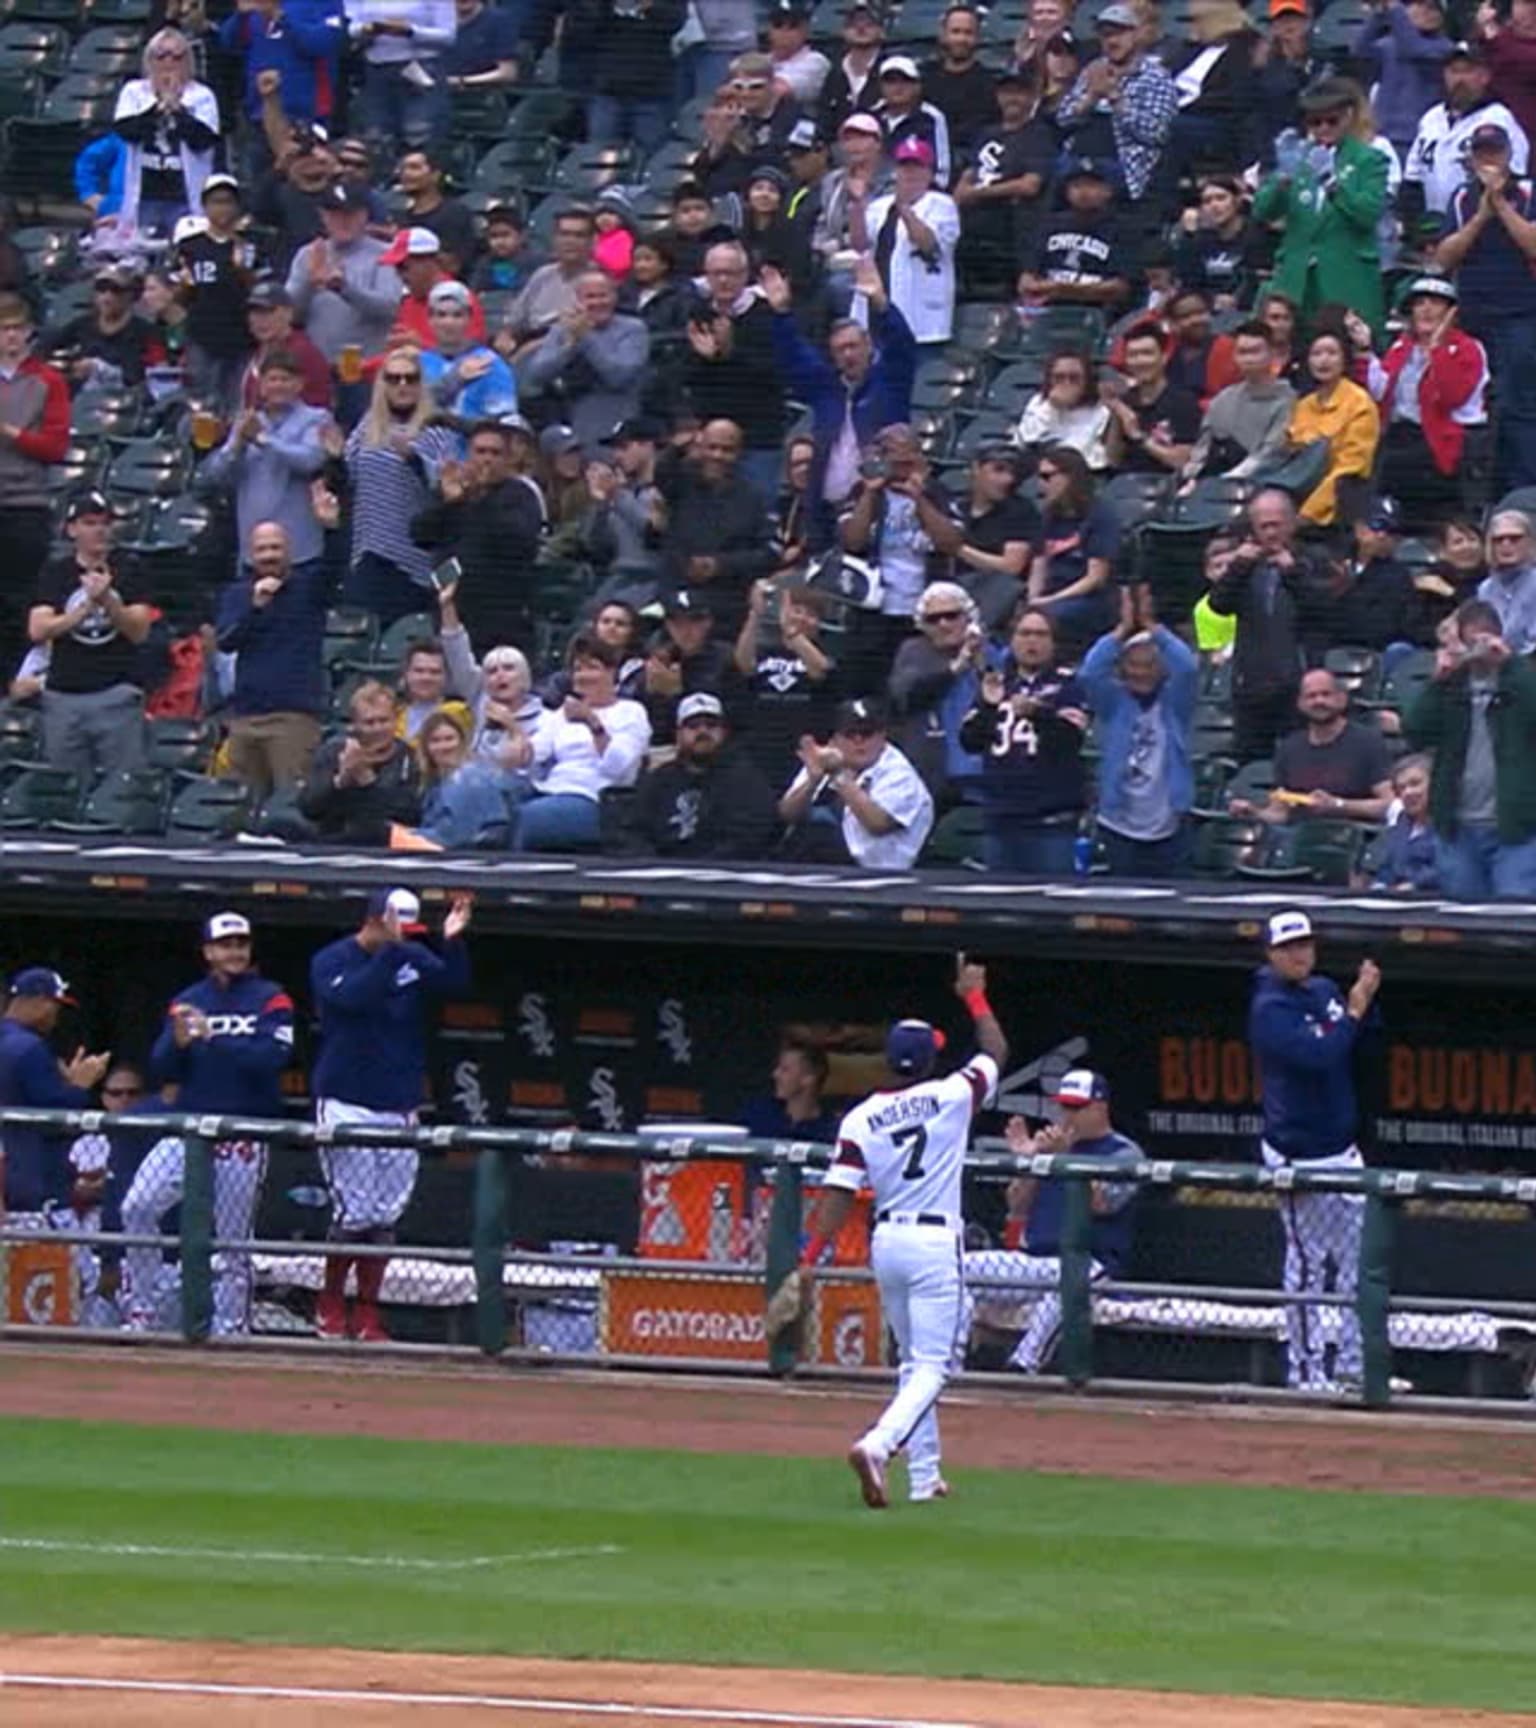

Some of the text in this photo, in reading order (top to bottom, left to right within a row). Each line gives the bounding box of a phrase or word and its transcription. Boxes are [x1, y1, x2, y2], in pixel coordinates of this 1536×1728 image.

[991, 701, 1038, 756] 34
[867, 1095, 940, 1134] ANDERSON
[1377, 1119, 1401, 1142] THE
[890, 1124, 928, 1180] 7
[24, 1272, 57, 1325] G
